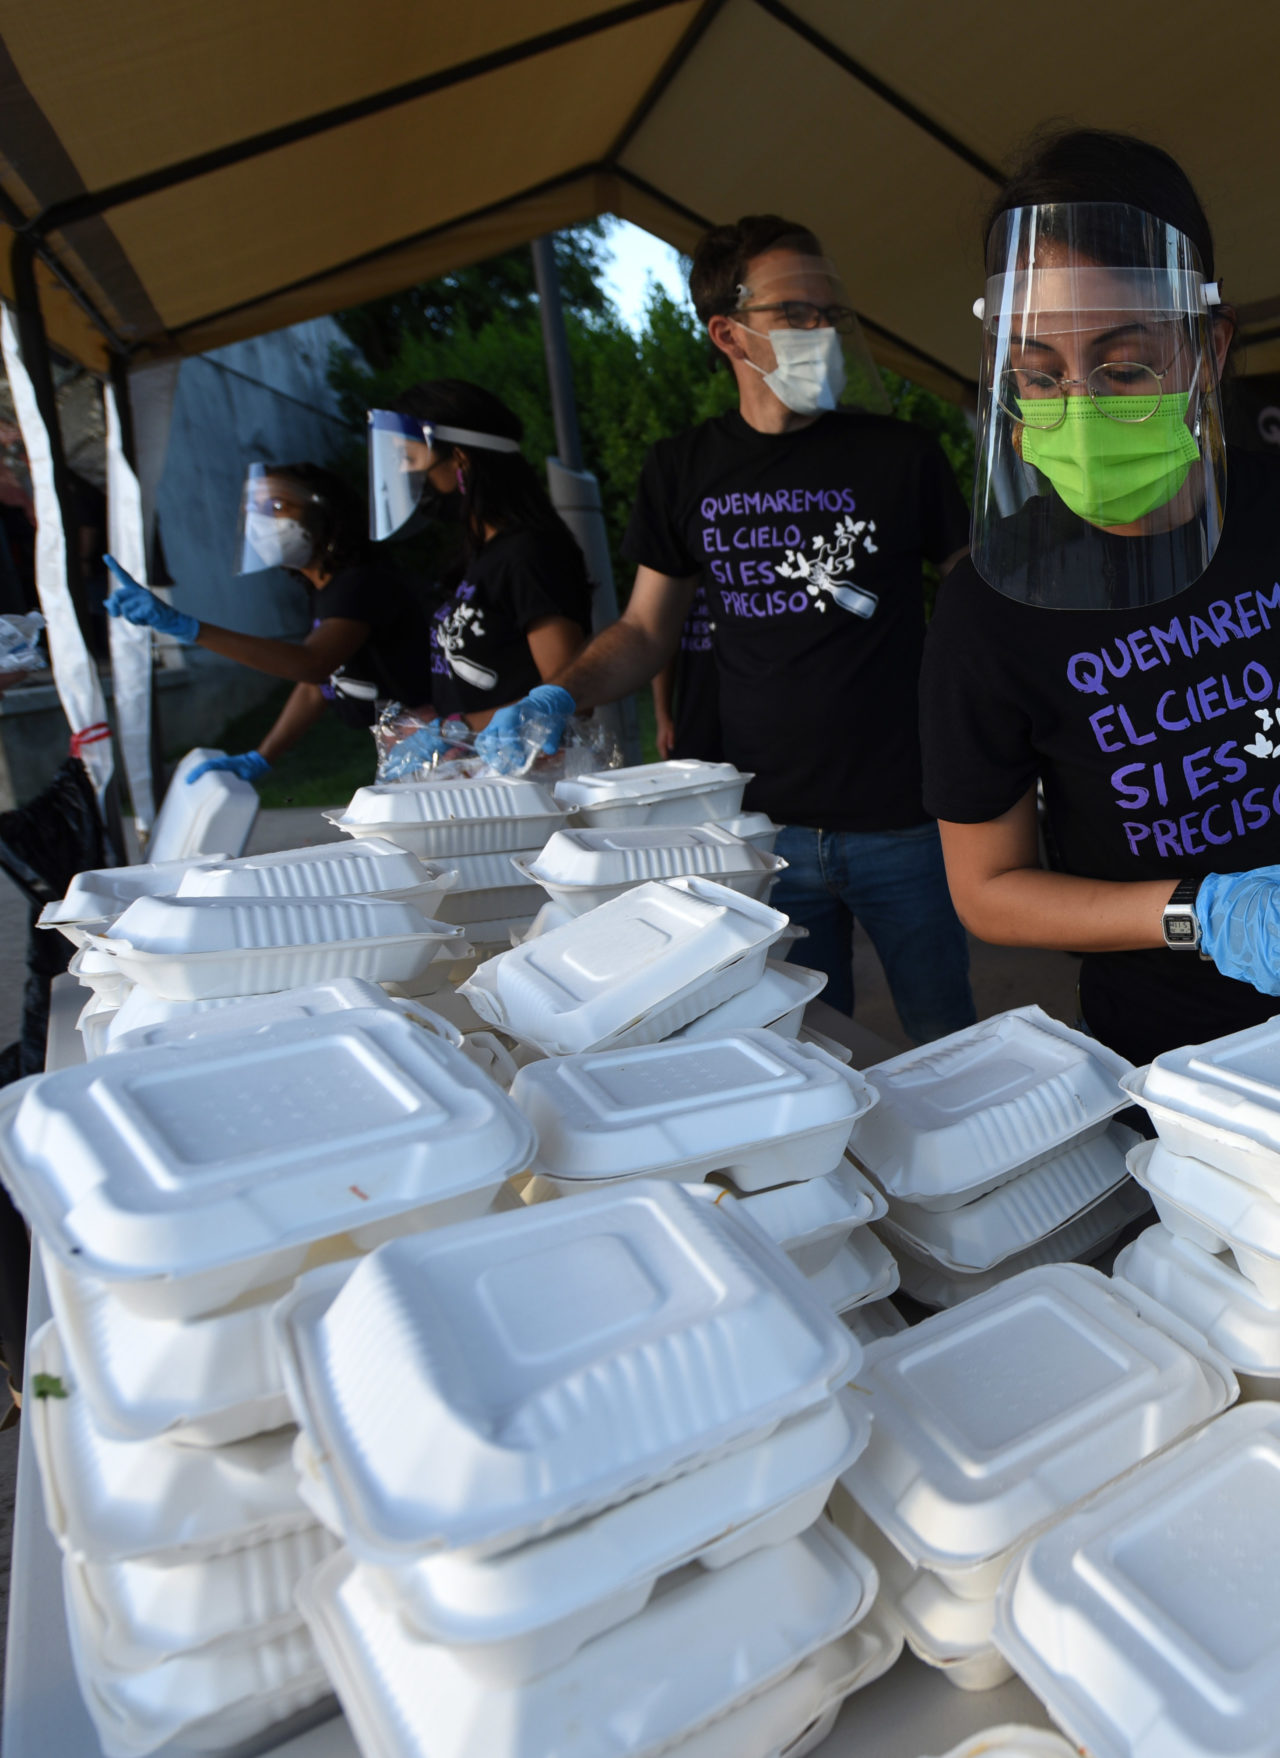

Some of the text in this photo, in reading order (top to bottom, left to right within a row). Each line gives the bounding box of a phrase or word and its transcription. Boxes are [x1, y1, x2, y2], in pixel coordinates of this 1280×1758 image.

[701, 488, 856, 521] QUEMAREMOS
[702, 524, 805, 552] EL CIELO,
[711, 560, 776, 586] SI ES
[720, 591, 808, 618] PRECISO
[1089, 704, 1157, 752] EL
[1110, 740, 1248, 810] SI ES
